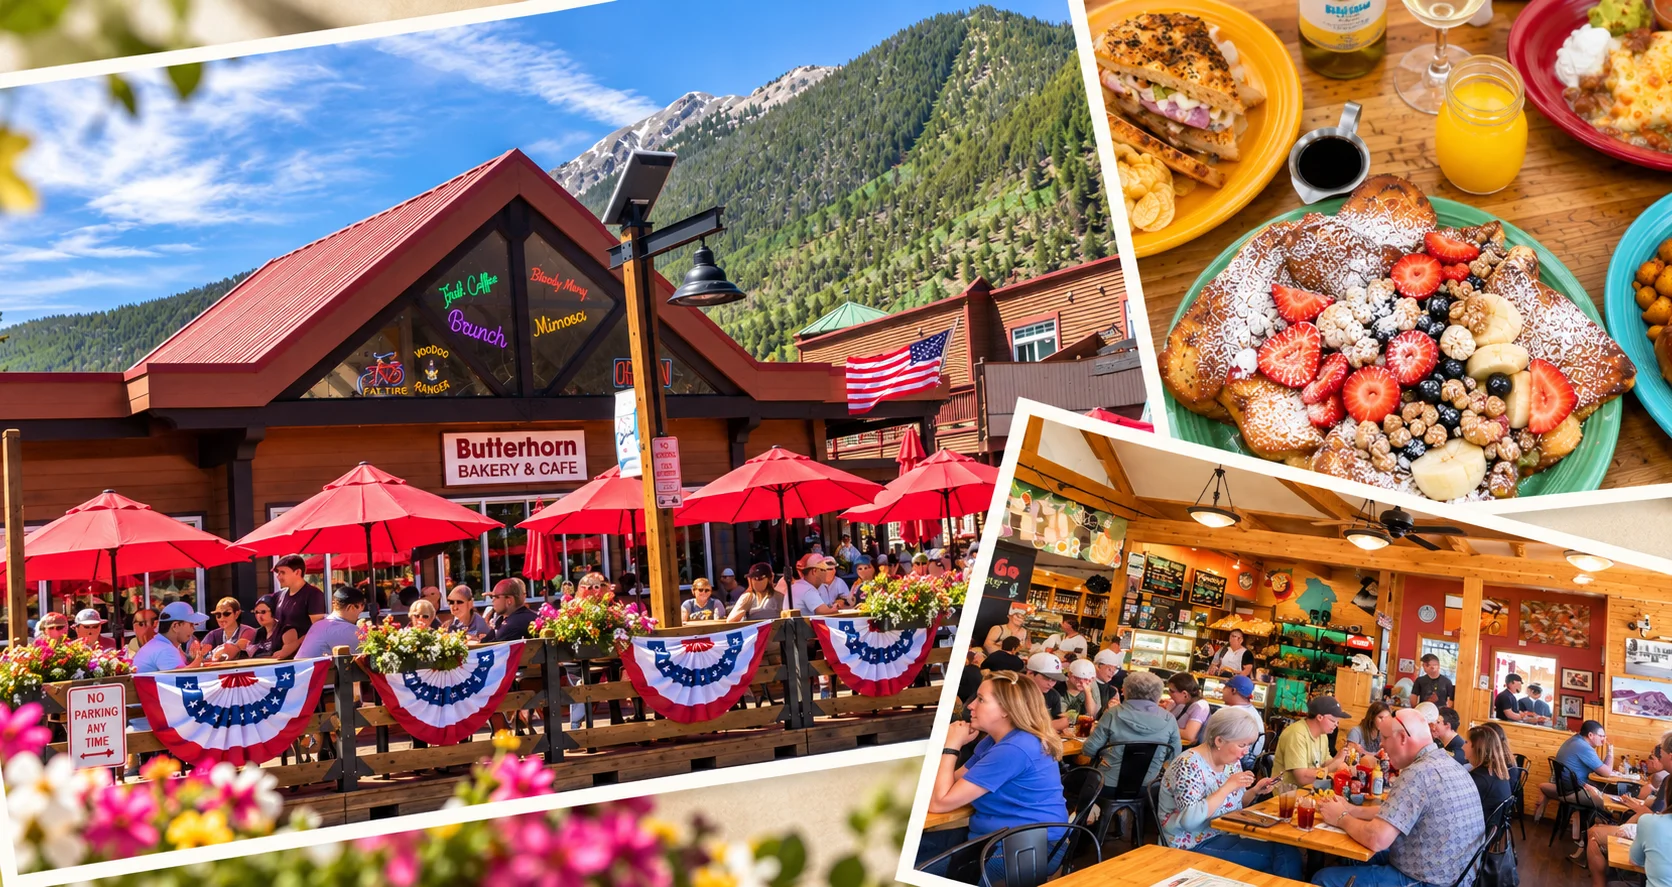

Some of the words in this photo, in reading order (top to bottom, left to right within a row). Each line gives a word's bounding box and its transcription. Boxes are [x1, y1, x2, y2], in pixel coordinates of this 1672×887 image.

[530, 267, 563, 293] Bloody
[448, 308, 508, 349] Brunch
[414, 345, 449, 358] VOODOO
[363, 387, 381, 396] FAT
[385, 387, 408, 395] TIRE
[456, 437, 577, 459] Butterhorn
[458, 463, 519, 478] BAKERY
[524, 462, 535, 476] &
[540, 461, 578, 475] CAFE
[87, 692, 105, 703] NO
[74, 706, 119, 720] PARKING
[87, 722, 107, 734] ANY
[85, 736, 109, 748] TIME
